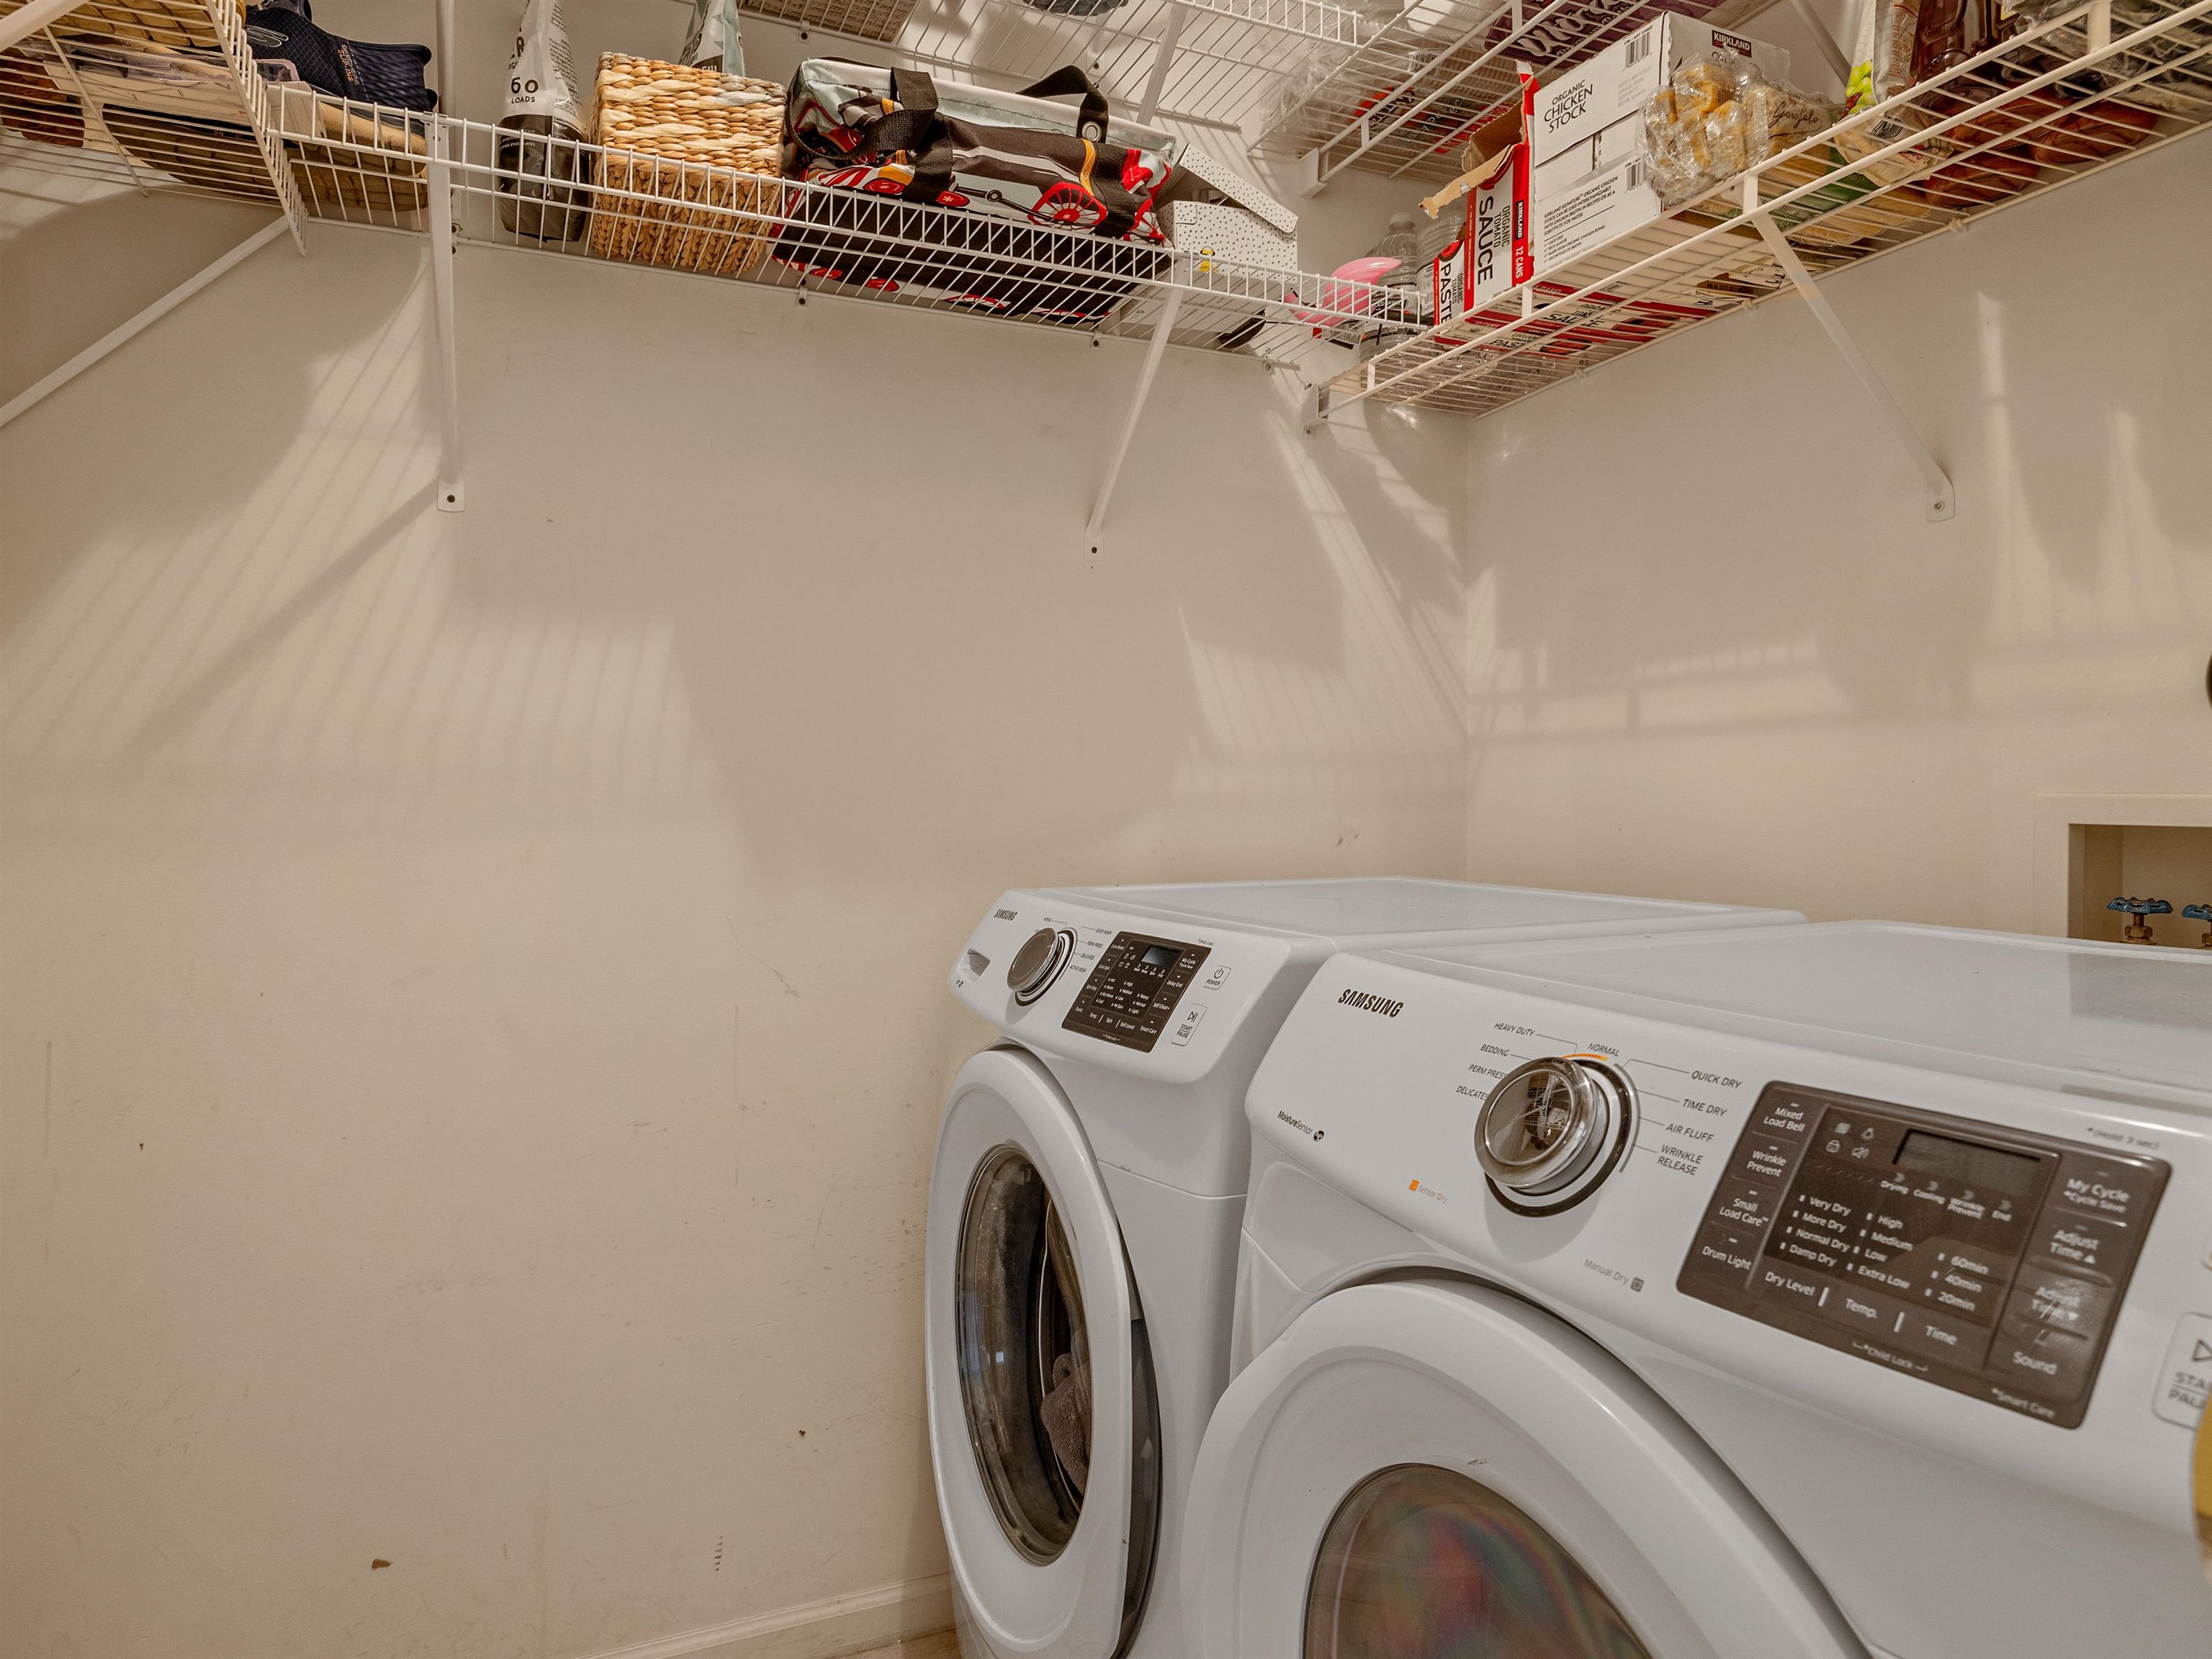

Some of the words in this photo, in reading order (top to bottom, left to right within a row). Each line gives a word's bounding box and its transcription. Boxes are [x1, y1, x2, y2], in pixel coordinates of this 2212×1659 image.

[1714, 32, 1750, 50] KIRKLAND
[511, 77, 539, 94] 60
[1552, 80, 1585, 105] ORGANIC
[1545, 84, 1593, 122] CHICKEN
[1550, 102, 1586, 133] STOCK
[1768, 101, 1819, 129] Garofalo
[1545, 206, 1561, 217] KIRKLAND
[1584, 185, 1600, 197] ORGANIC
[1601, 176, 1618, 188] CHICKEN
[1502, 205, 1511, 247] ORGANIC
[1554, 215, 1569, 226] CHICKEN
[1570, 209, 1581, 219] BROTH
[1478, 196, 1494, 285] SAUCE
[1516, 246, 1524, 256] 12
[1441, 262, 1452, 324] PASTE
[1337, 988, 1404, 1018] SAMSUNG
[1493, 1022, 1515, 1033] HEAVY
[1516, 1027, 1535, 1036] DUTY
[1480, 1044, 1510, 1057] BEDDING
[1587, 1043, 1620, 1056] NORMAL
[1469, 1064, 1487, 1075] PERM
[1487, 1069, 1508, 1080] PRESS
[1691, 1071, 1720, 1084] QUICK
[1721, 1077, 1743, 1089] DRY
[1456, 1085, 1490, 1101] DELICATES
[1682, 1099, 1706, 1112] TIME
[1706, 1105, 1727, 1117] DRY
[1775, 1107, 1804, 1120] Mixed
[1665, 1123, 1683, 1135] AIR
[1684, 1128, 1714, 1142] FLUFF
[1763, 1116, 1786, 1128] Load
[1787, 1121, 1806, 1133] Bell
[1660, 1143, 1704, 1165] WRINKLE
[1752, 1151, 1787, 1166] Wrinkle
[1657, 1156, 1698, 1176] RELEASE
[1746, 1161, 1783, 1177] Prevent
[1417, 1184, 1437, 1198] Sensor
[1436, 1191, 1449, 1204] Dry
[1880, 1180, 1909, 1195] Drying
[1913, 1189, 1946, 1205] Cooling
[2067, 1178, 2090, 1193] My
[2091, 1184, 2131, 1202] Cycle
[1719, 1206, 1741, 1220] Load
[1732, 1198, 1758, 1213] Small
[1809, 1197, 1832, 1210] Very
[1832, 1203, 1852, 1216] Dry
[2099, 1200, 2127, 1213] Save
[1802, 1213, 1827, 1226] More
[1827, 1220, 1847, 1233] Dry
[1878, 1215, 1903, 1229] High
[1992, 1210, 2013, 1222] End
[1796, 1228, 1830, 1246] Normal
[1830, 1239, 1851, 1252] Dry
[1871, 1231, 1914, 1251] Medium
[2054, 1230, 2099, 1250] Adjust
[1702, 1246, 1727, 1260] Drum
[1727, 1254, 1753, 1271] Light
[1789, 1244, 1817, 1261] Damp
[1817, 1253, 1837, 1267] Dry
[1864, 1249, 1887, 1262] Low
[2050, 1241, 2084, 1260] Time
[1584, 1259, 1613, 1277] Manual
[1613, 1271, 1630, 1286] Dry
[1951, 1256, 1989, 1274] 60min
[1765, 1272, 1786, 1287] Dry
[1786, 1279, 1816, 1296] Level
[1858, 1265, 1886, 1282] Extra
[1887, 1275, 1911, 1289] Low
[1945, 1274, 1982, 1292] 40min
[1845, 1298, 1878, 1319] Temp.
[1938, 1291, 1976, 1311] 20min
[1925, 1325, 1958, 1346] Time
[1891, 1354, 1914, 1369] Lock
[2012, 1352, 2057, 1375] Sound
[2029, 1403, 2056, 1419] Care
